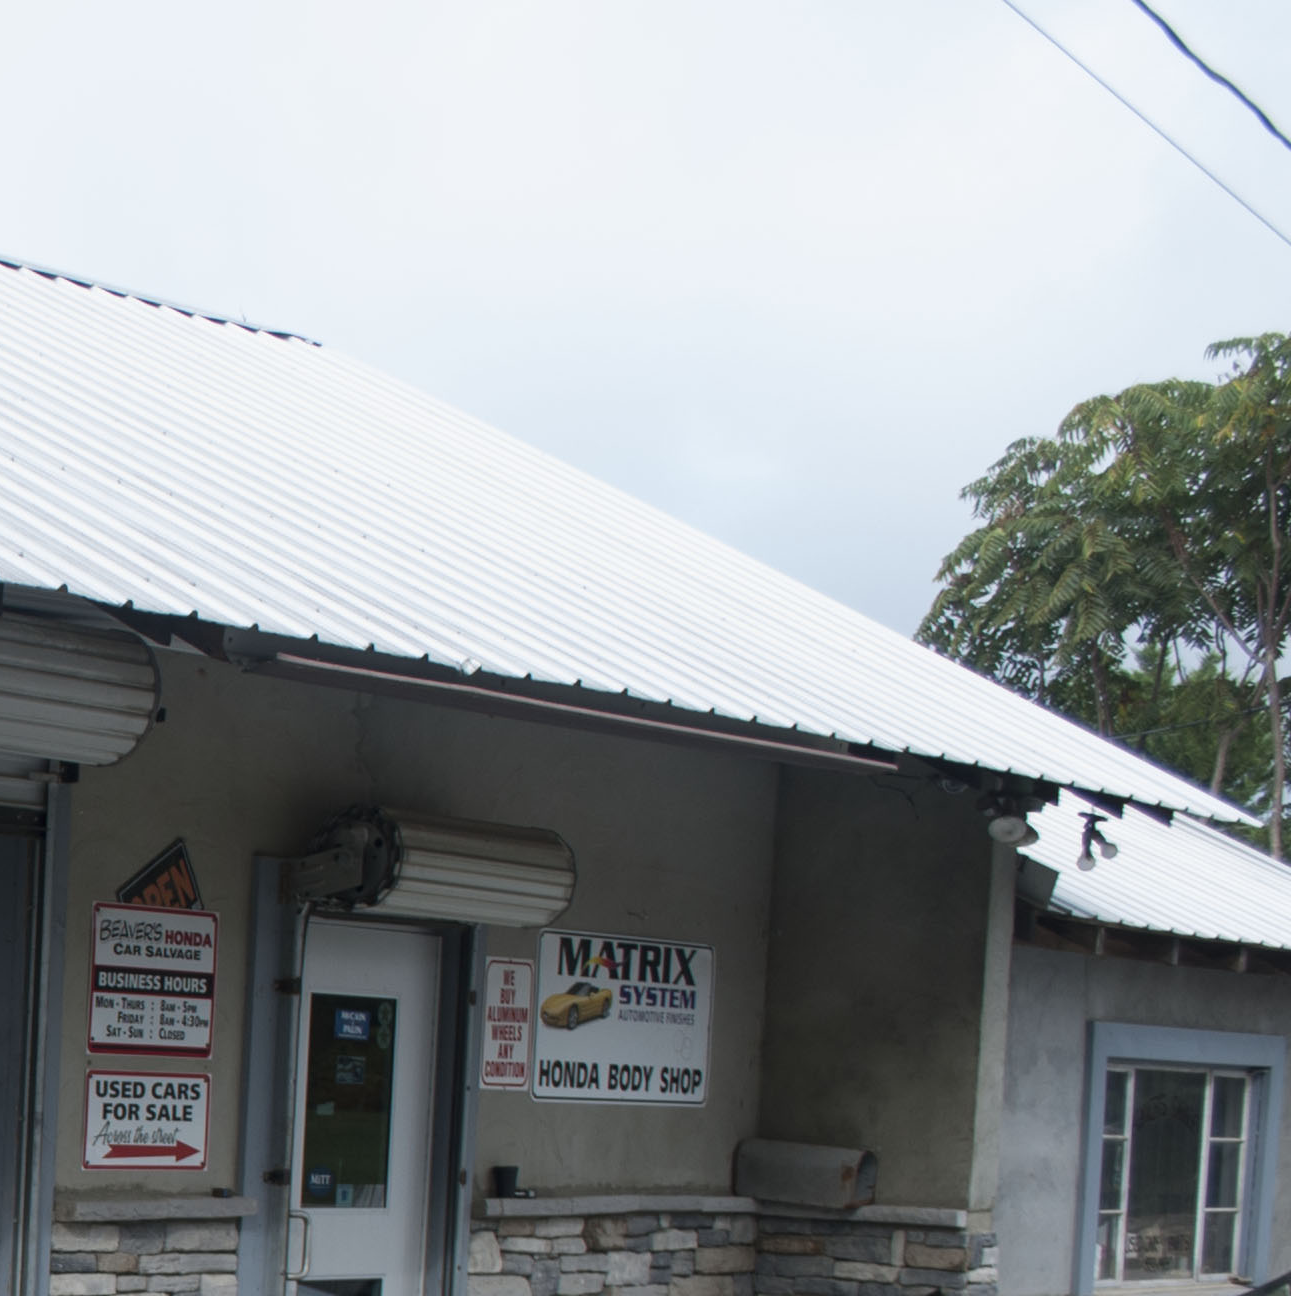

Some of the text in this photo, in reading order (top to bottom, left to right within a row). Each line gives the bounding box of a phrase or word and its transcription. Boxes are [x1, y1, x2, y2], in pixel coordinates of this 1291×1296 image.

[131, 859, 196, 908] PEN
[99, 919, 212, 948] BEAVER'S HONDA
[114, 943, 201, 960] CAR SALVAGE
[557, 936, 696, 986] MATRIX
[98, 971, 207, 993] BUSINESS HOURS
[500, 988, 516, 1005] BUY
[619, 985, 696, 1010] SYSTEM
[487, 1006, 528, 1023] ALUMINUM
[618, 1010, 695, 1026] AUTOMOTIVE FINISHES
[491, 1024, 522, 1042] WHEELS
[498, 1043, 514, 1059] ANY
[485, 1060, 525, 1078] CONDITION
[539, 1060, 702, 1095] HONDA BODY SHOP
[96, 1080, 201, 1100] USED CARS
[102, 1103, 193, 1122] FOR SALE
[92, 1121, 180, 1146] Across the street
